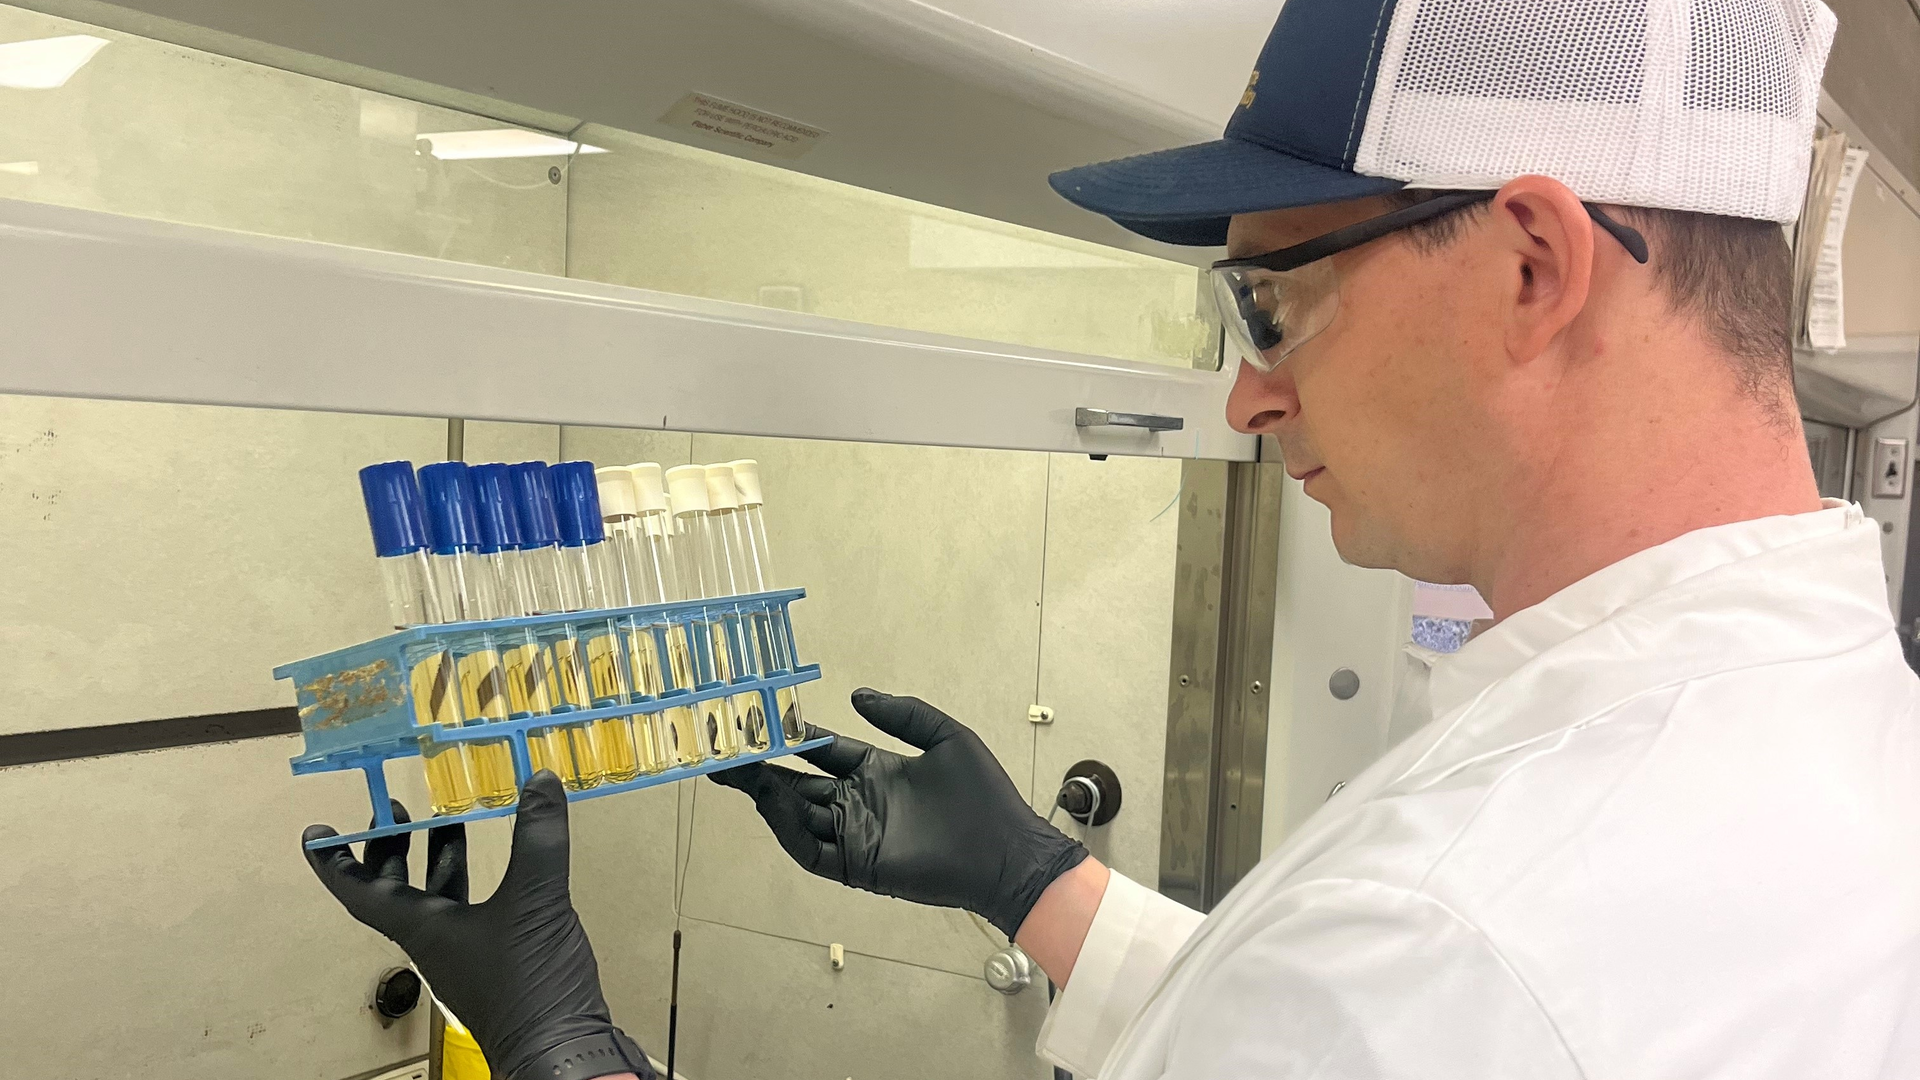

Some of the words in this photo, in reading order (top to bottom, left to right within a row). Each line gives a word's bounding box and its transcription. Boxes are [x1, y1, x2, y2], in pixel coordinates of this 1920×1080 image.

[729, 107, 751, 118] HOOD
[757, 115, 773, 124] NOT
[691, 120, 715, 131] Fisher
[714, 126, 745, 140] Scientific
[744, 135, 775, 148] Company
